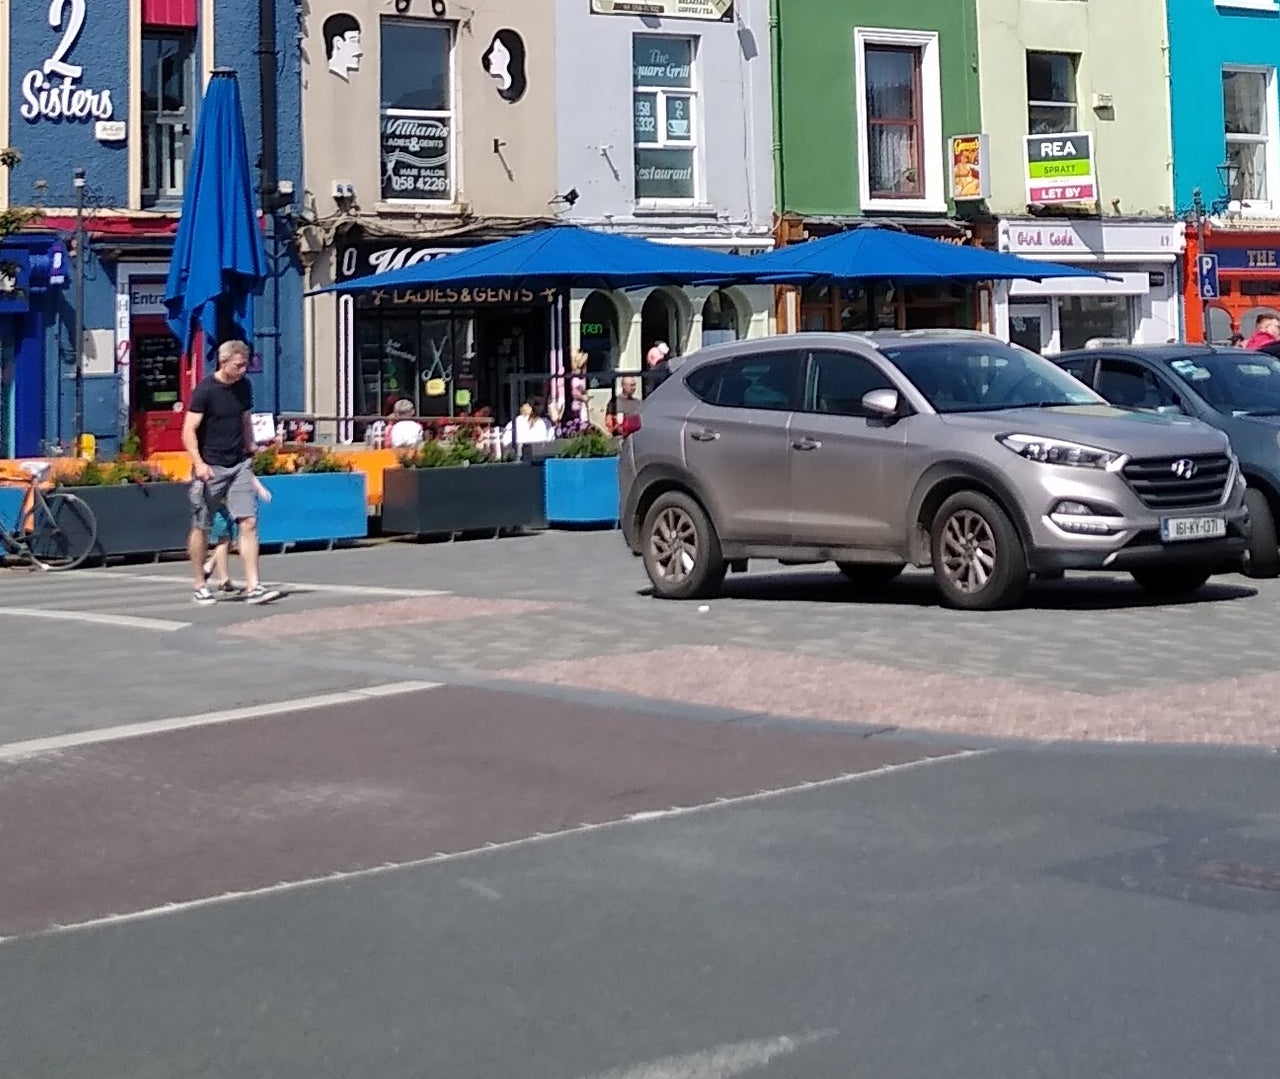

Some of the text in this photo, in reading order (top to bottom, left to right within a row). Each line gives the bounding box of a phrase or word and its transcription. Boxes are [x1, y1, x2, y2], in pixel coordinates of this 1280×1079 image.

[650, 49, 670, 64] The
[634, 63, 690, 79] quare Grill
[21, 69, 113, 119] Sisters
[1040, 141, 1077, 157] REA
[636, 166, 692, 180] estaurant
[1043, 165, 1076, 174] SPRATT
[416, 177, 451, 191] 42261
[1041, 187, 1081, 199] LET BY
[1202, 258, 1212, 270] P
[1247, 250, 1277, 267] THE
